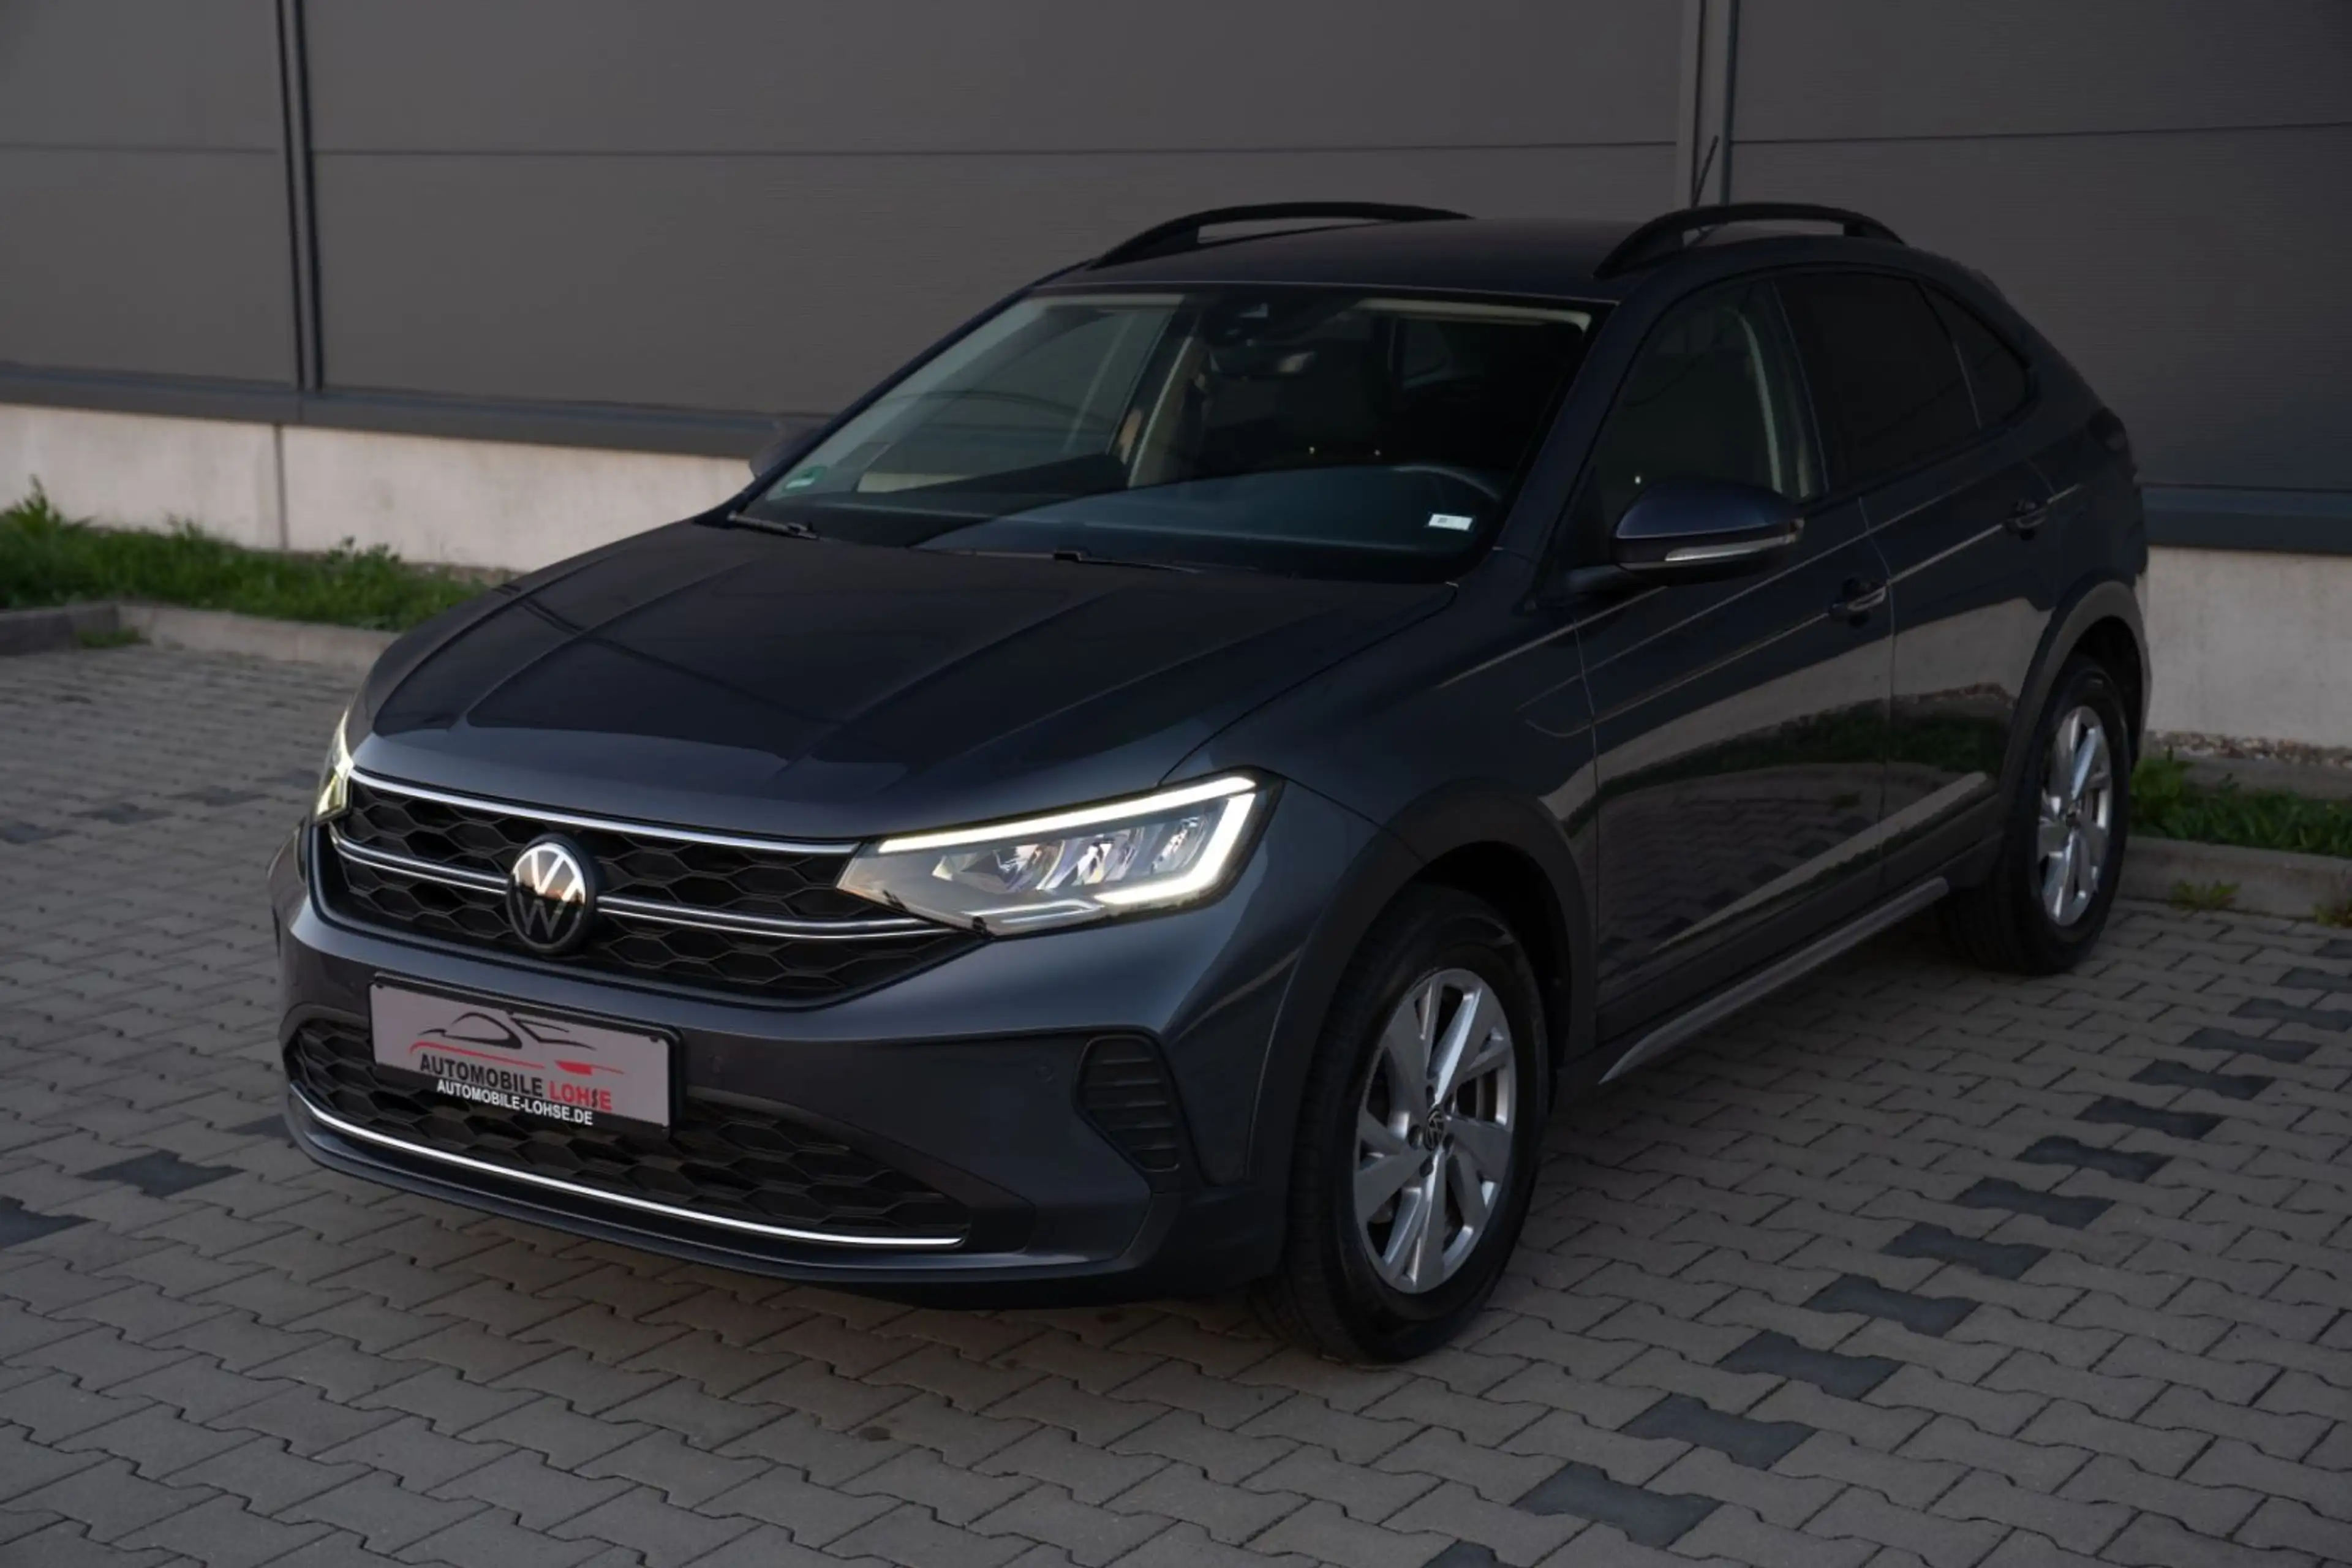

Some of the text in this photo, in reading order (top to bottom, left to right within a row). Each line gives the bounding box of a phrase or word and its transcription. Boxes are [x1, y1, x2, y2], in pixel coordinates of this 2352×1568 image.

[420, 1053, 612, 1110] AUTOMOBILE LOHSE
[436, 1079, 594, 1126] AUTOMOBILE-LOHSE.DE
